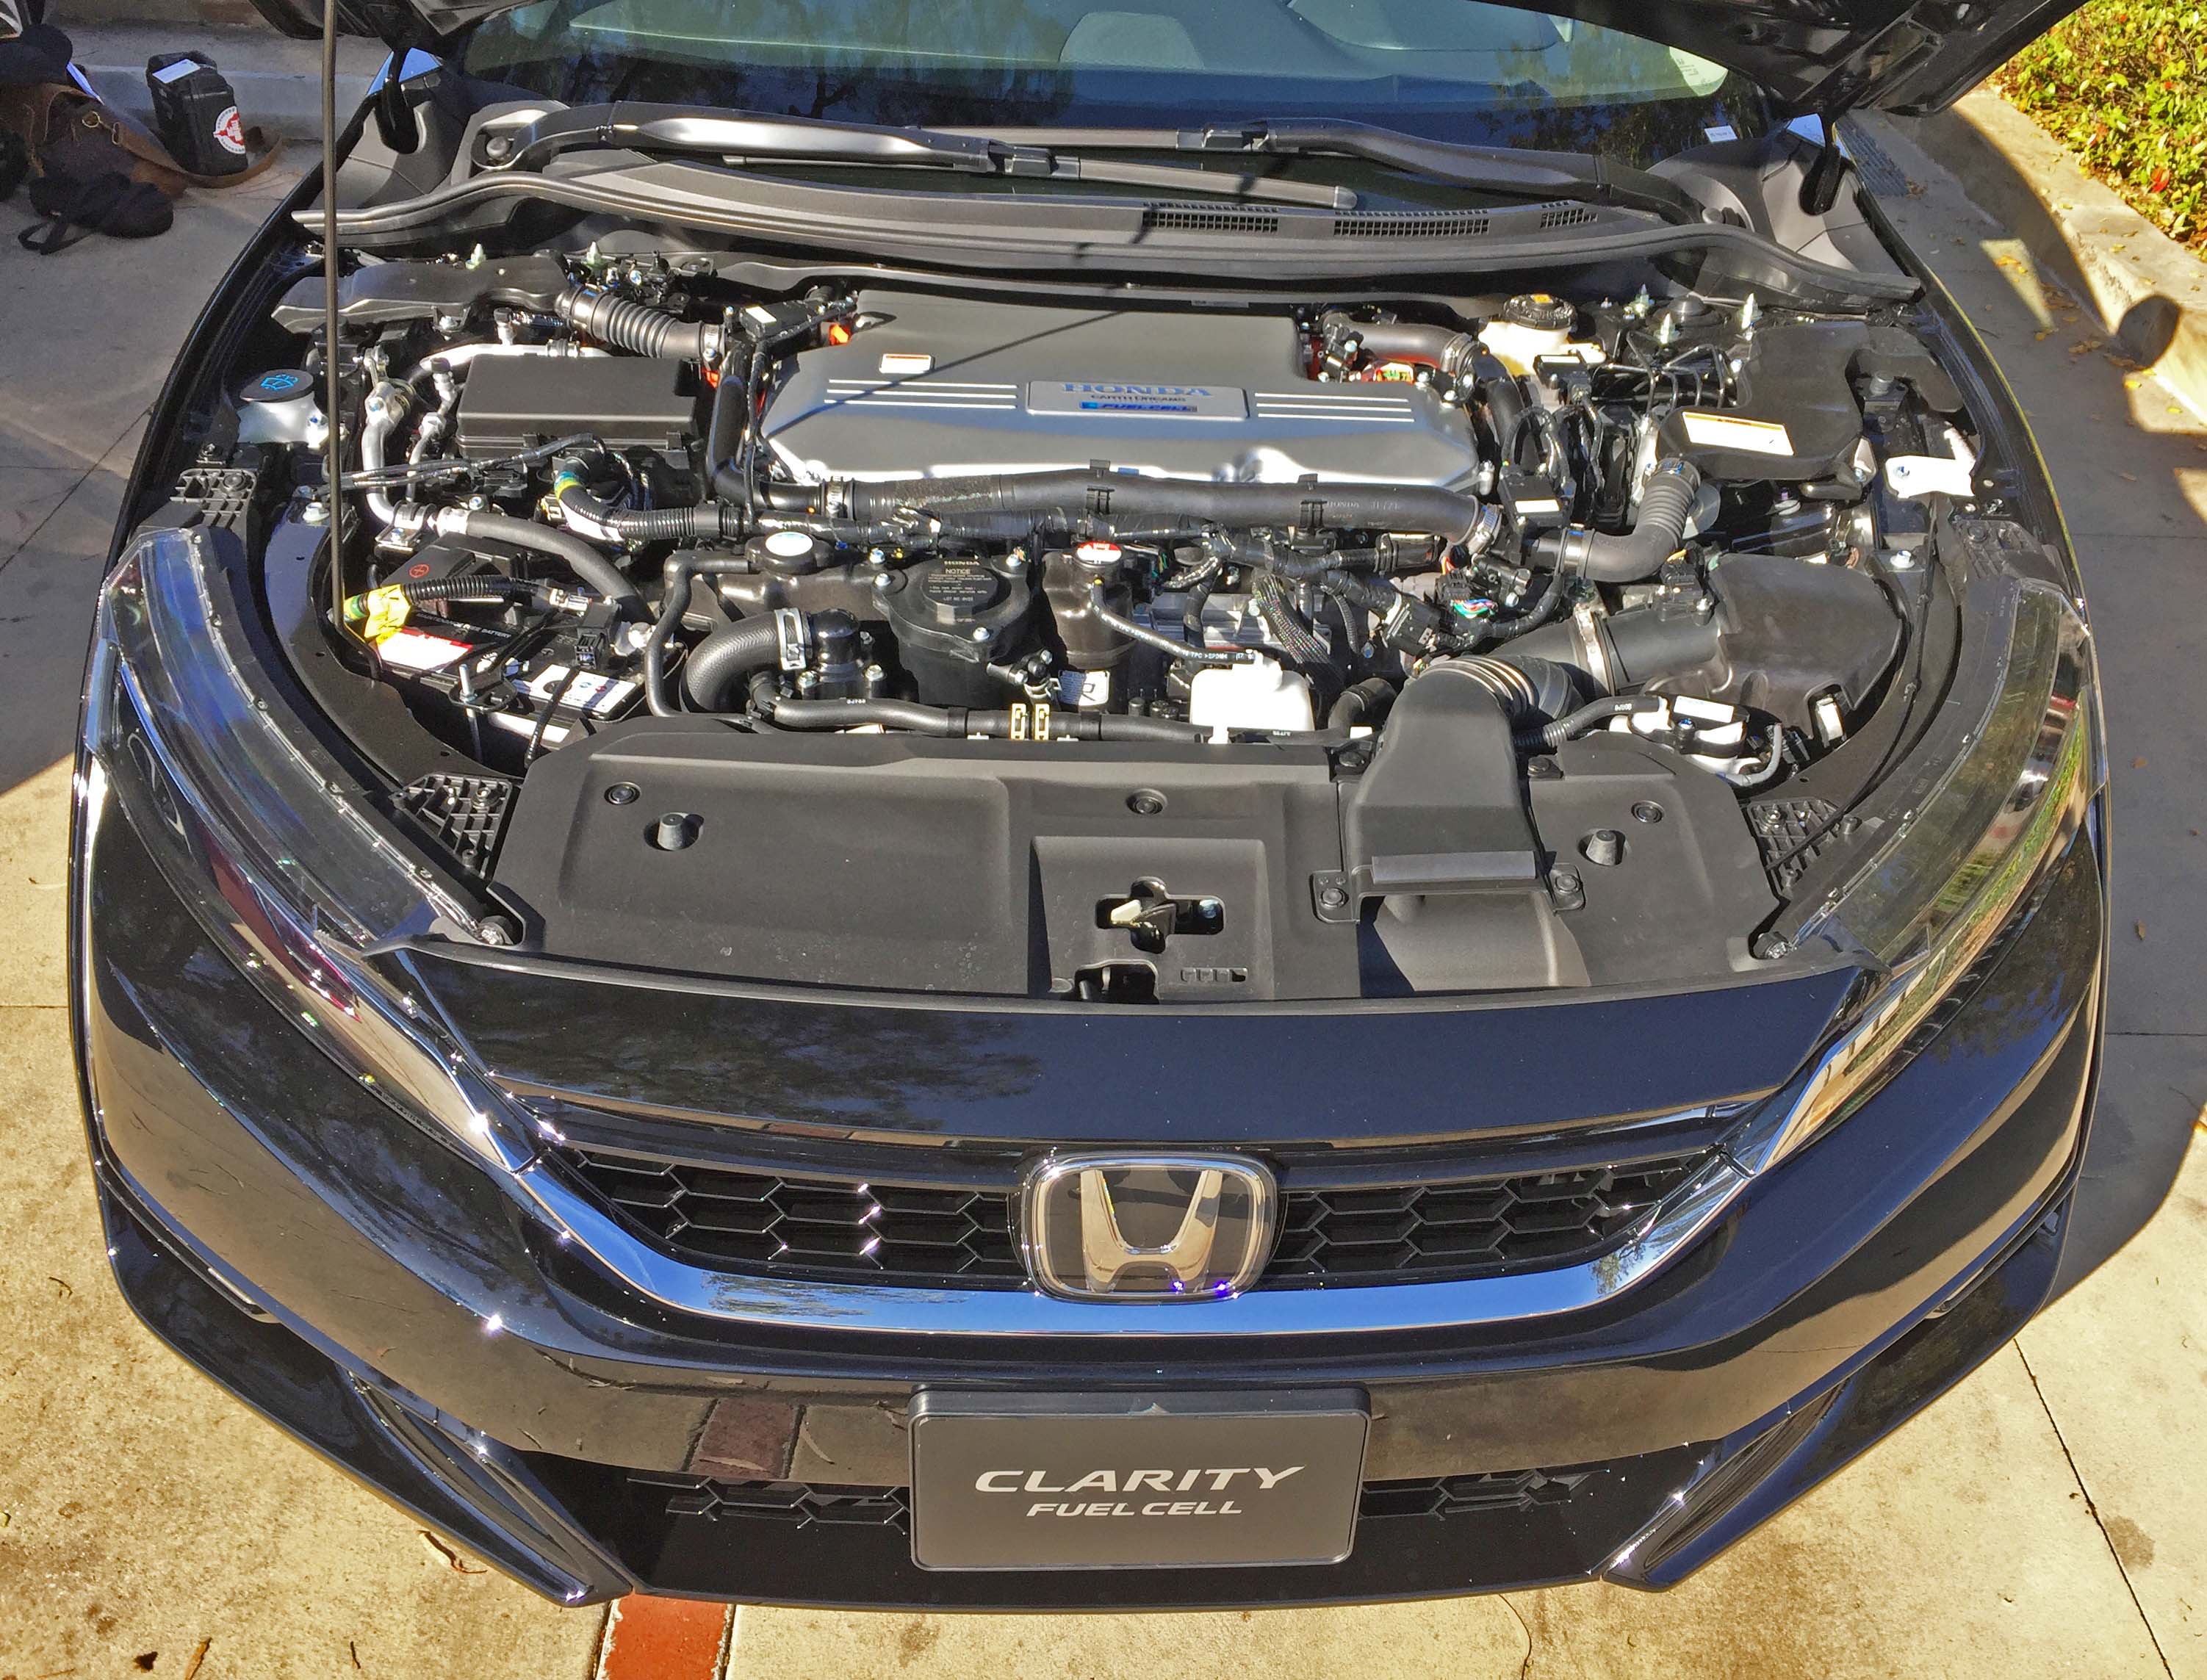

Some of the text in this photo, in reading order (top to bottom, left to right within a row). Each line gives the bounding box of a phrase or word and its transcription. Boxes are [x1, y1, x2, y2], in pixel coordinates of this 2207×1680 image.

[1062, 383, 1213, 396] HONDA
[481, 628, 512, 638] BATTERY
[975, 1466, 1306, 1493] CLARITY
[1026, 1501, 1242, 1517] FUEL CELL
